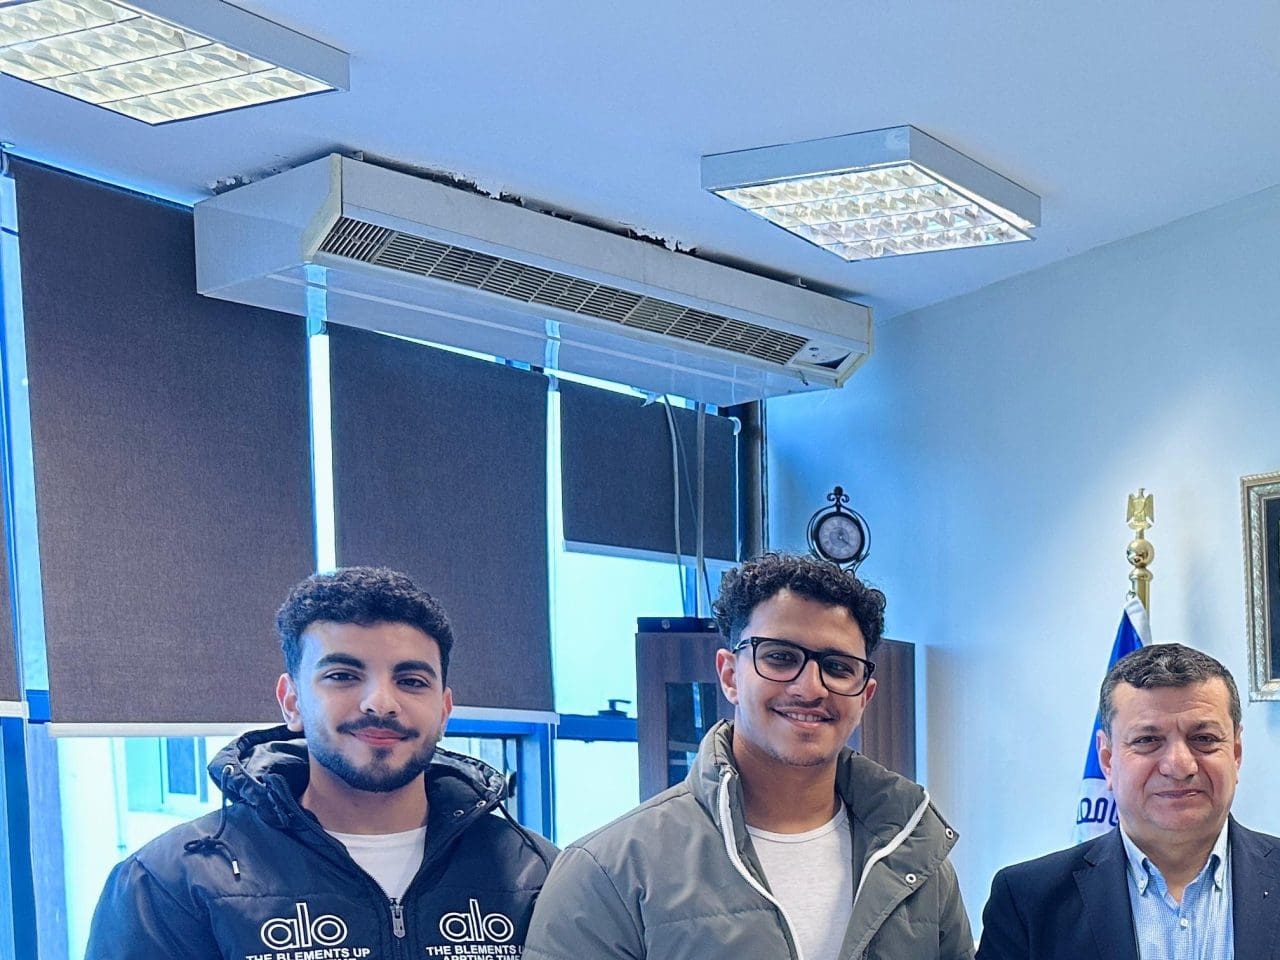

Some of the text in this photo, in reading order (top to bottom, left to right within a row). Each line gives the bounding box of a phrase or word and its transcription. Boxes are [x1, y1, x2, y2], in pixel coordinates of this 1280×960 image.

[260, 902, 348, 951] alo
[439, 898, 514, 942] alo
[353, 947, 371, 958] UP
[425, 945, 452, 956] THE
[454, 945, 516, 954] BLEMENTS
